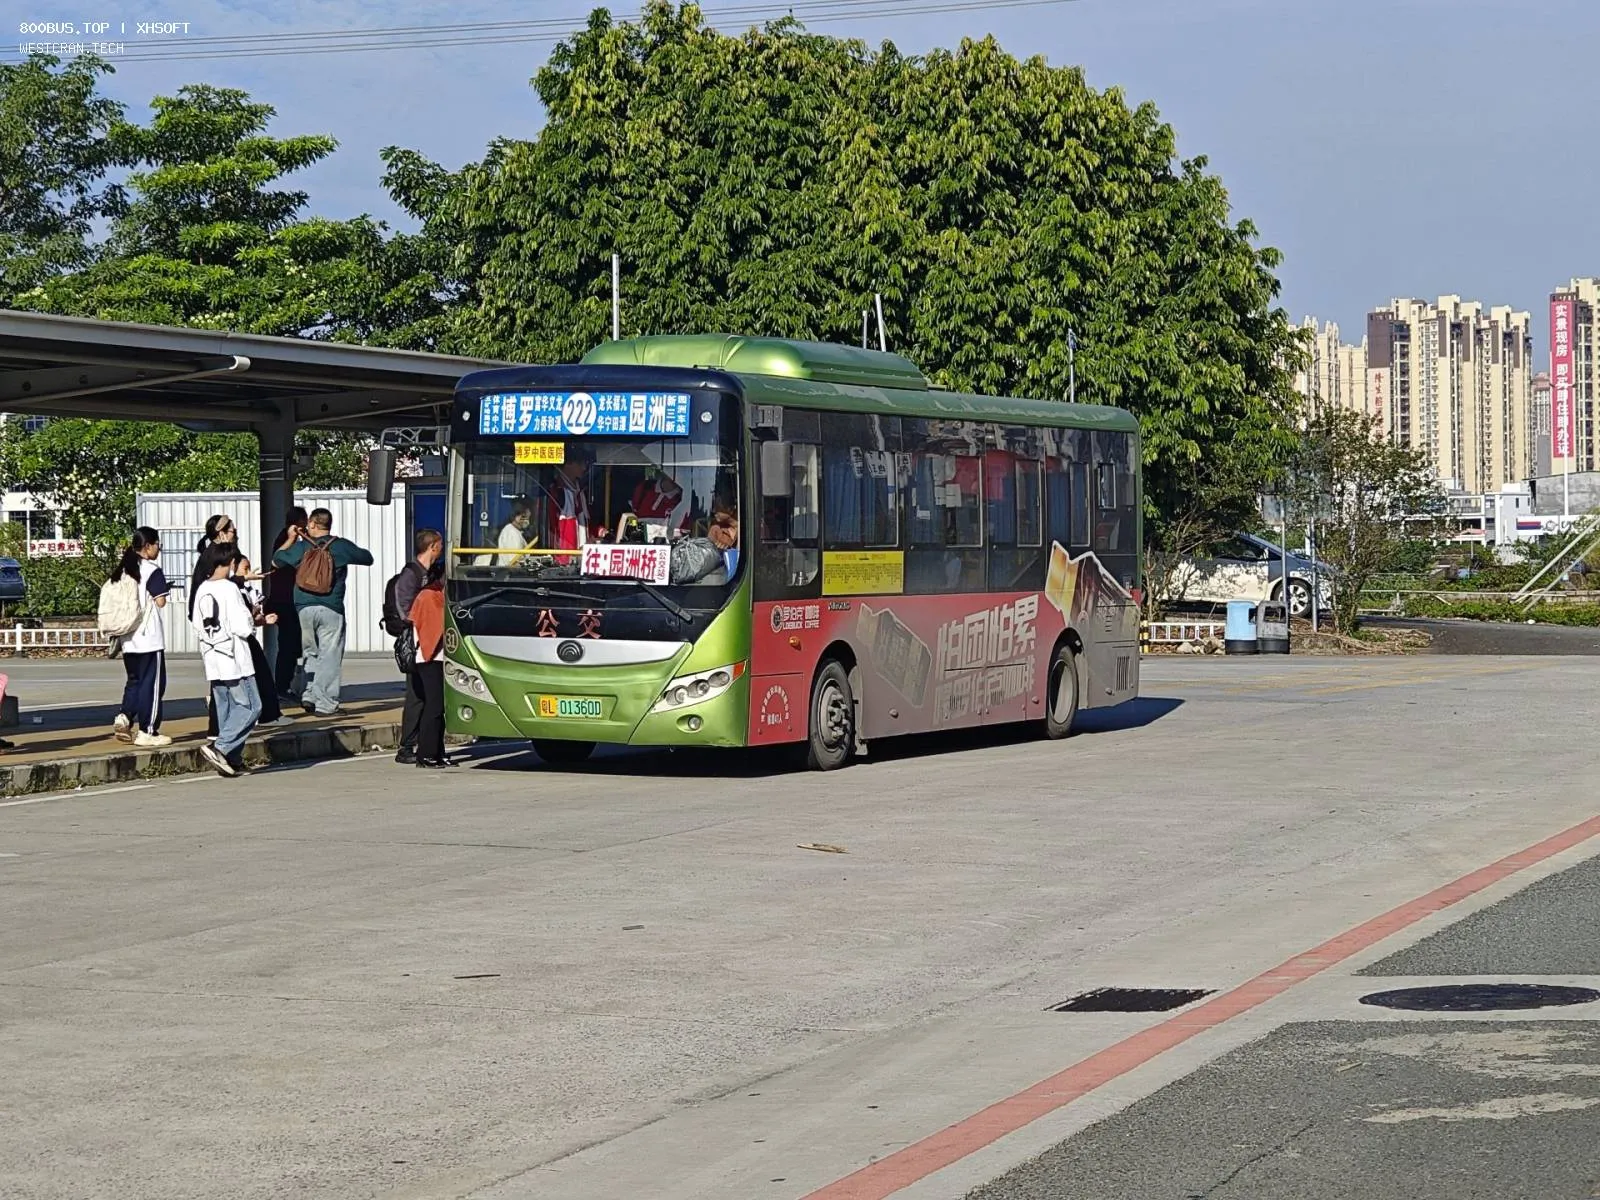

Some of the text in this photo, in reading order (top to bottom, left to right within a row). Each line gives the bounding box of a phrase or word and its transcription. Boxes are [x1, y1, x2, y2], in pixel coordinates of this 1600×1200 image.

[1554, 303, 1569, 358] 实景现房
[501, 394, 534, 433] 博罗
[566, 399, 593, 428] 222
[629, 394, 667, 433] 园洲
[535, 608, 603, 639] 公交
[935, 594, 1040, 681] 怕困怕累
